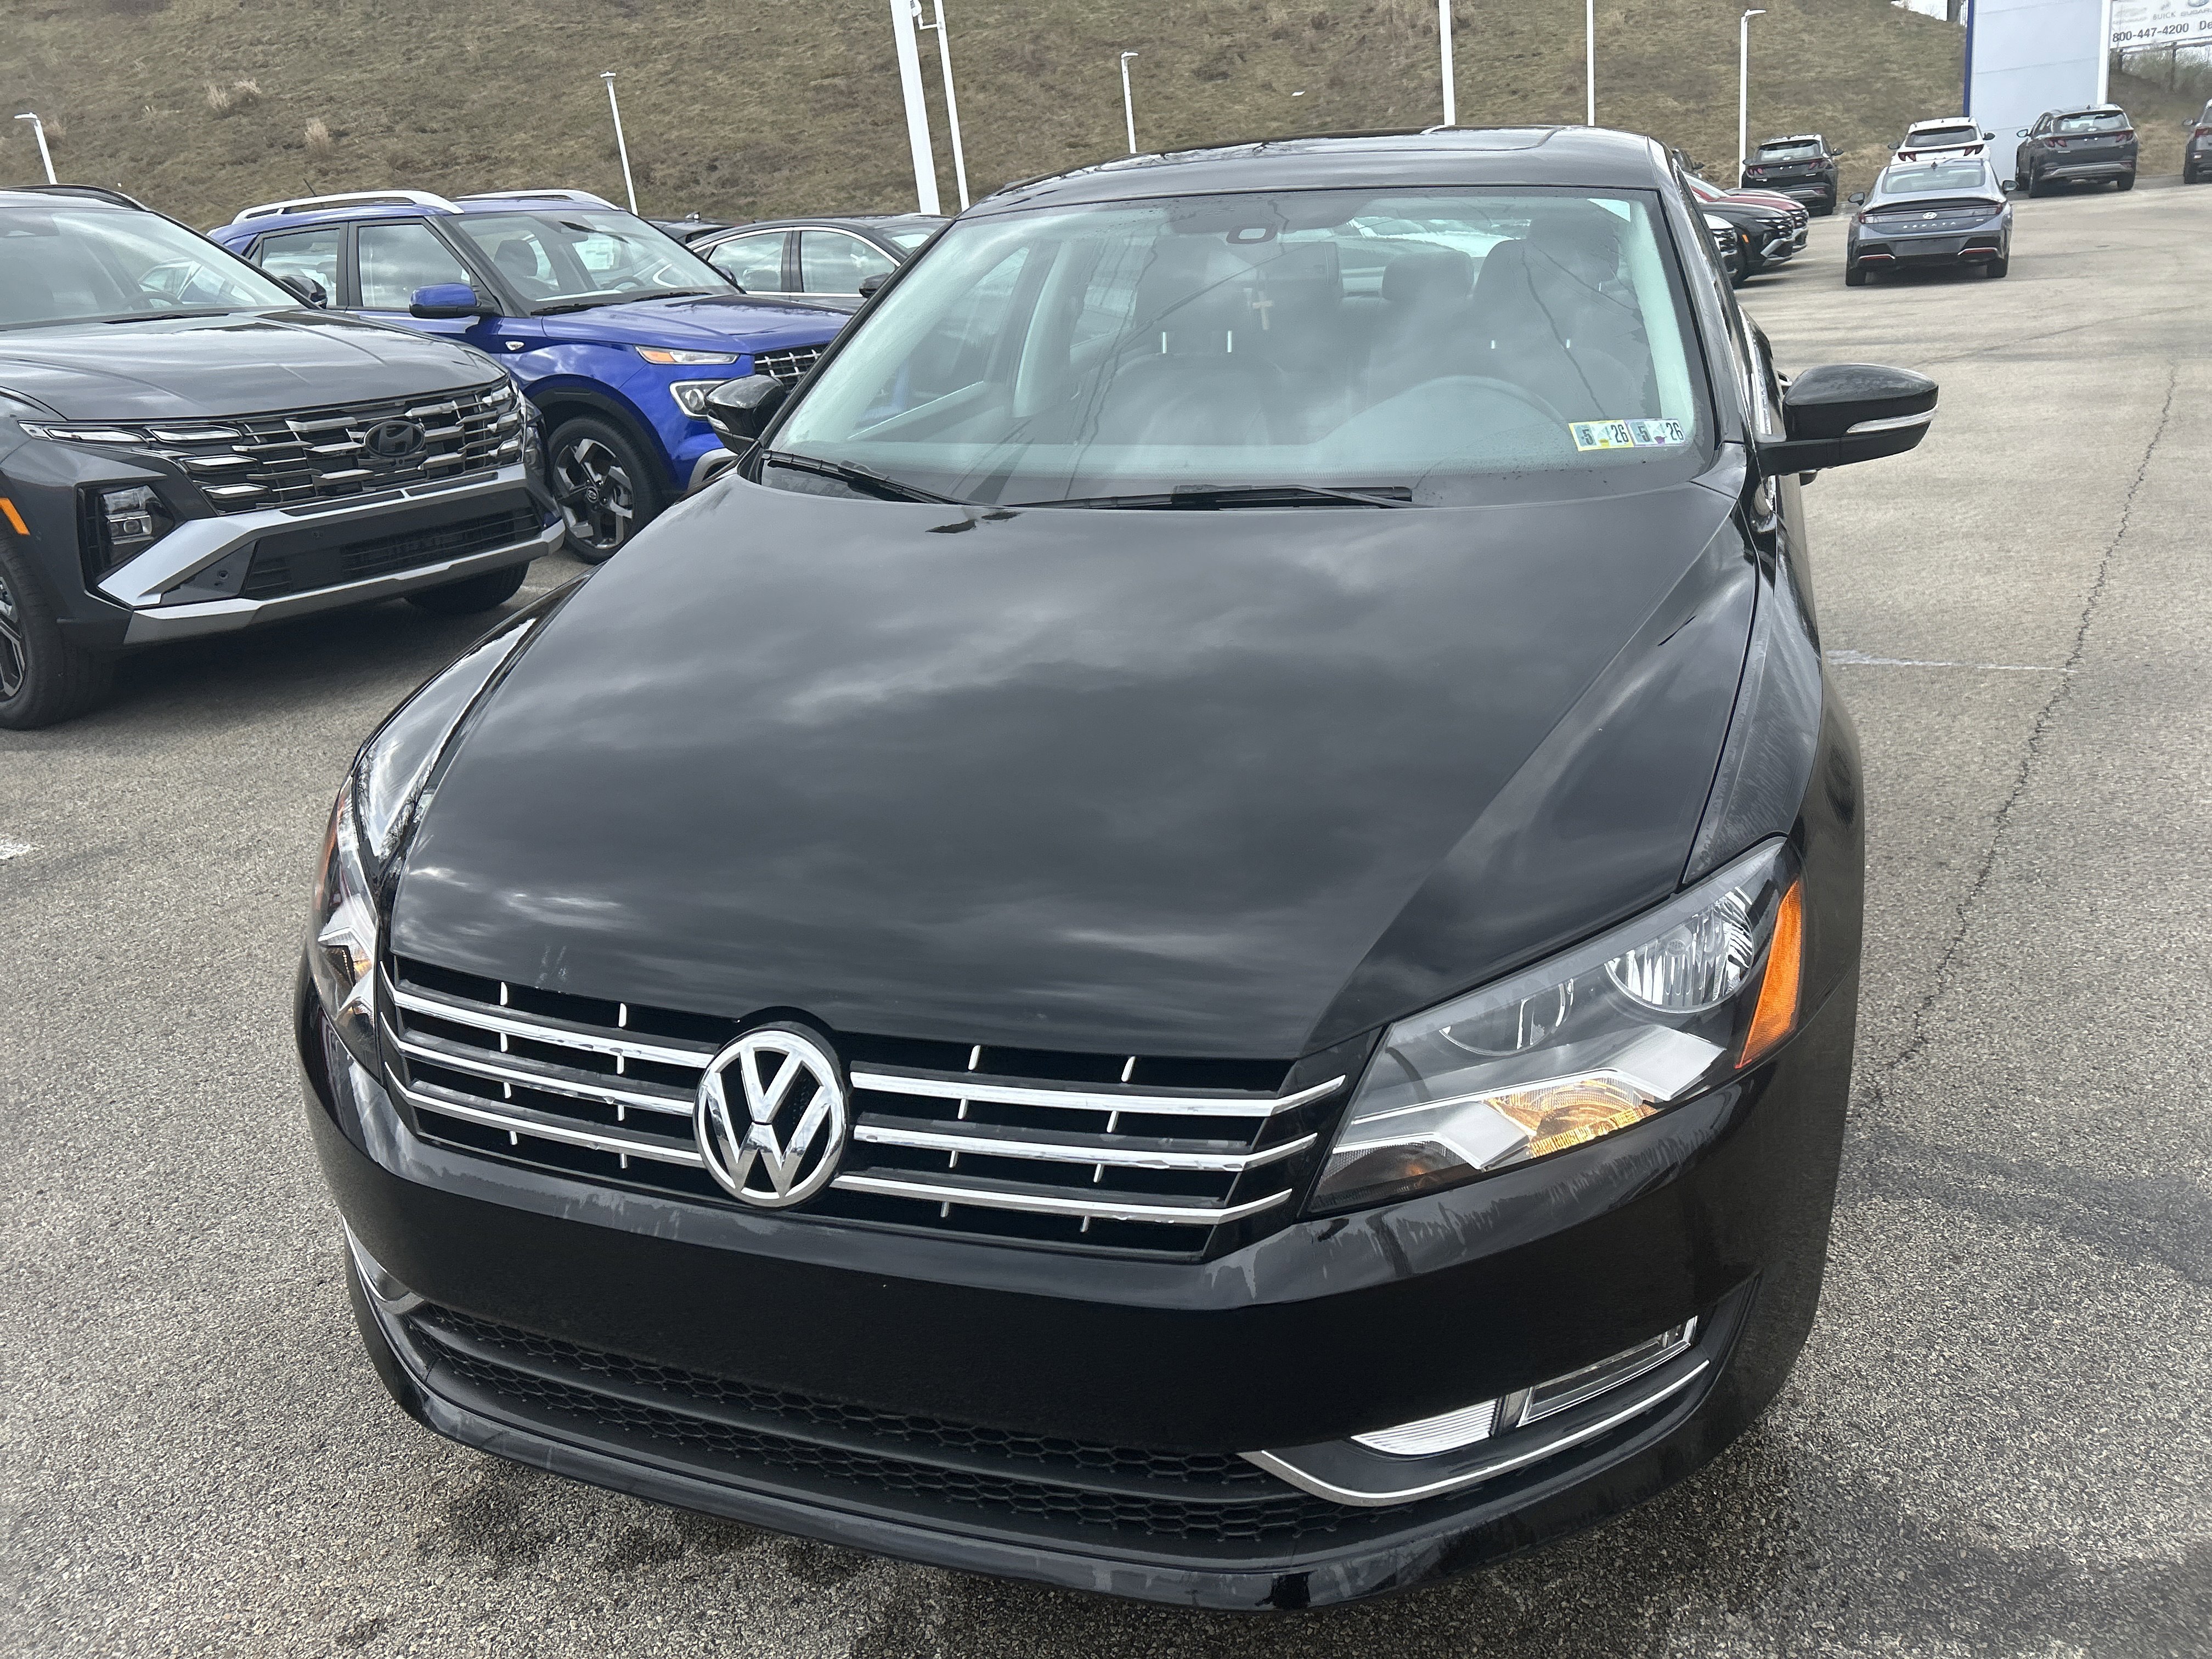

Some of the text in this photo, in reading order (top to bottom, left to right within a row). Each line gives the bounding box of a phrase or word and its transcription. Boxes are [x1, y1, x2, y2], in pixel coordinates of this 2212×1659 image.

[2153, 12, 2176, 20] BUICK
[2112, 22, 2190, 43] 800-447-4200
[1610, 424, 1629, 443] 26
[1666, 421, 1684, 441] 26
